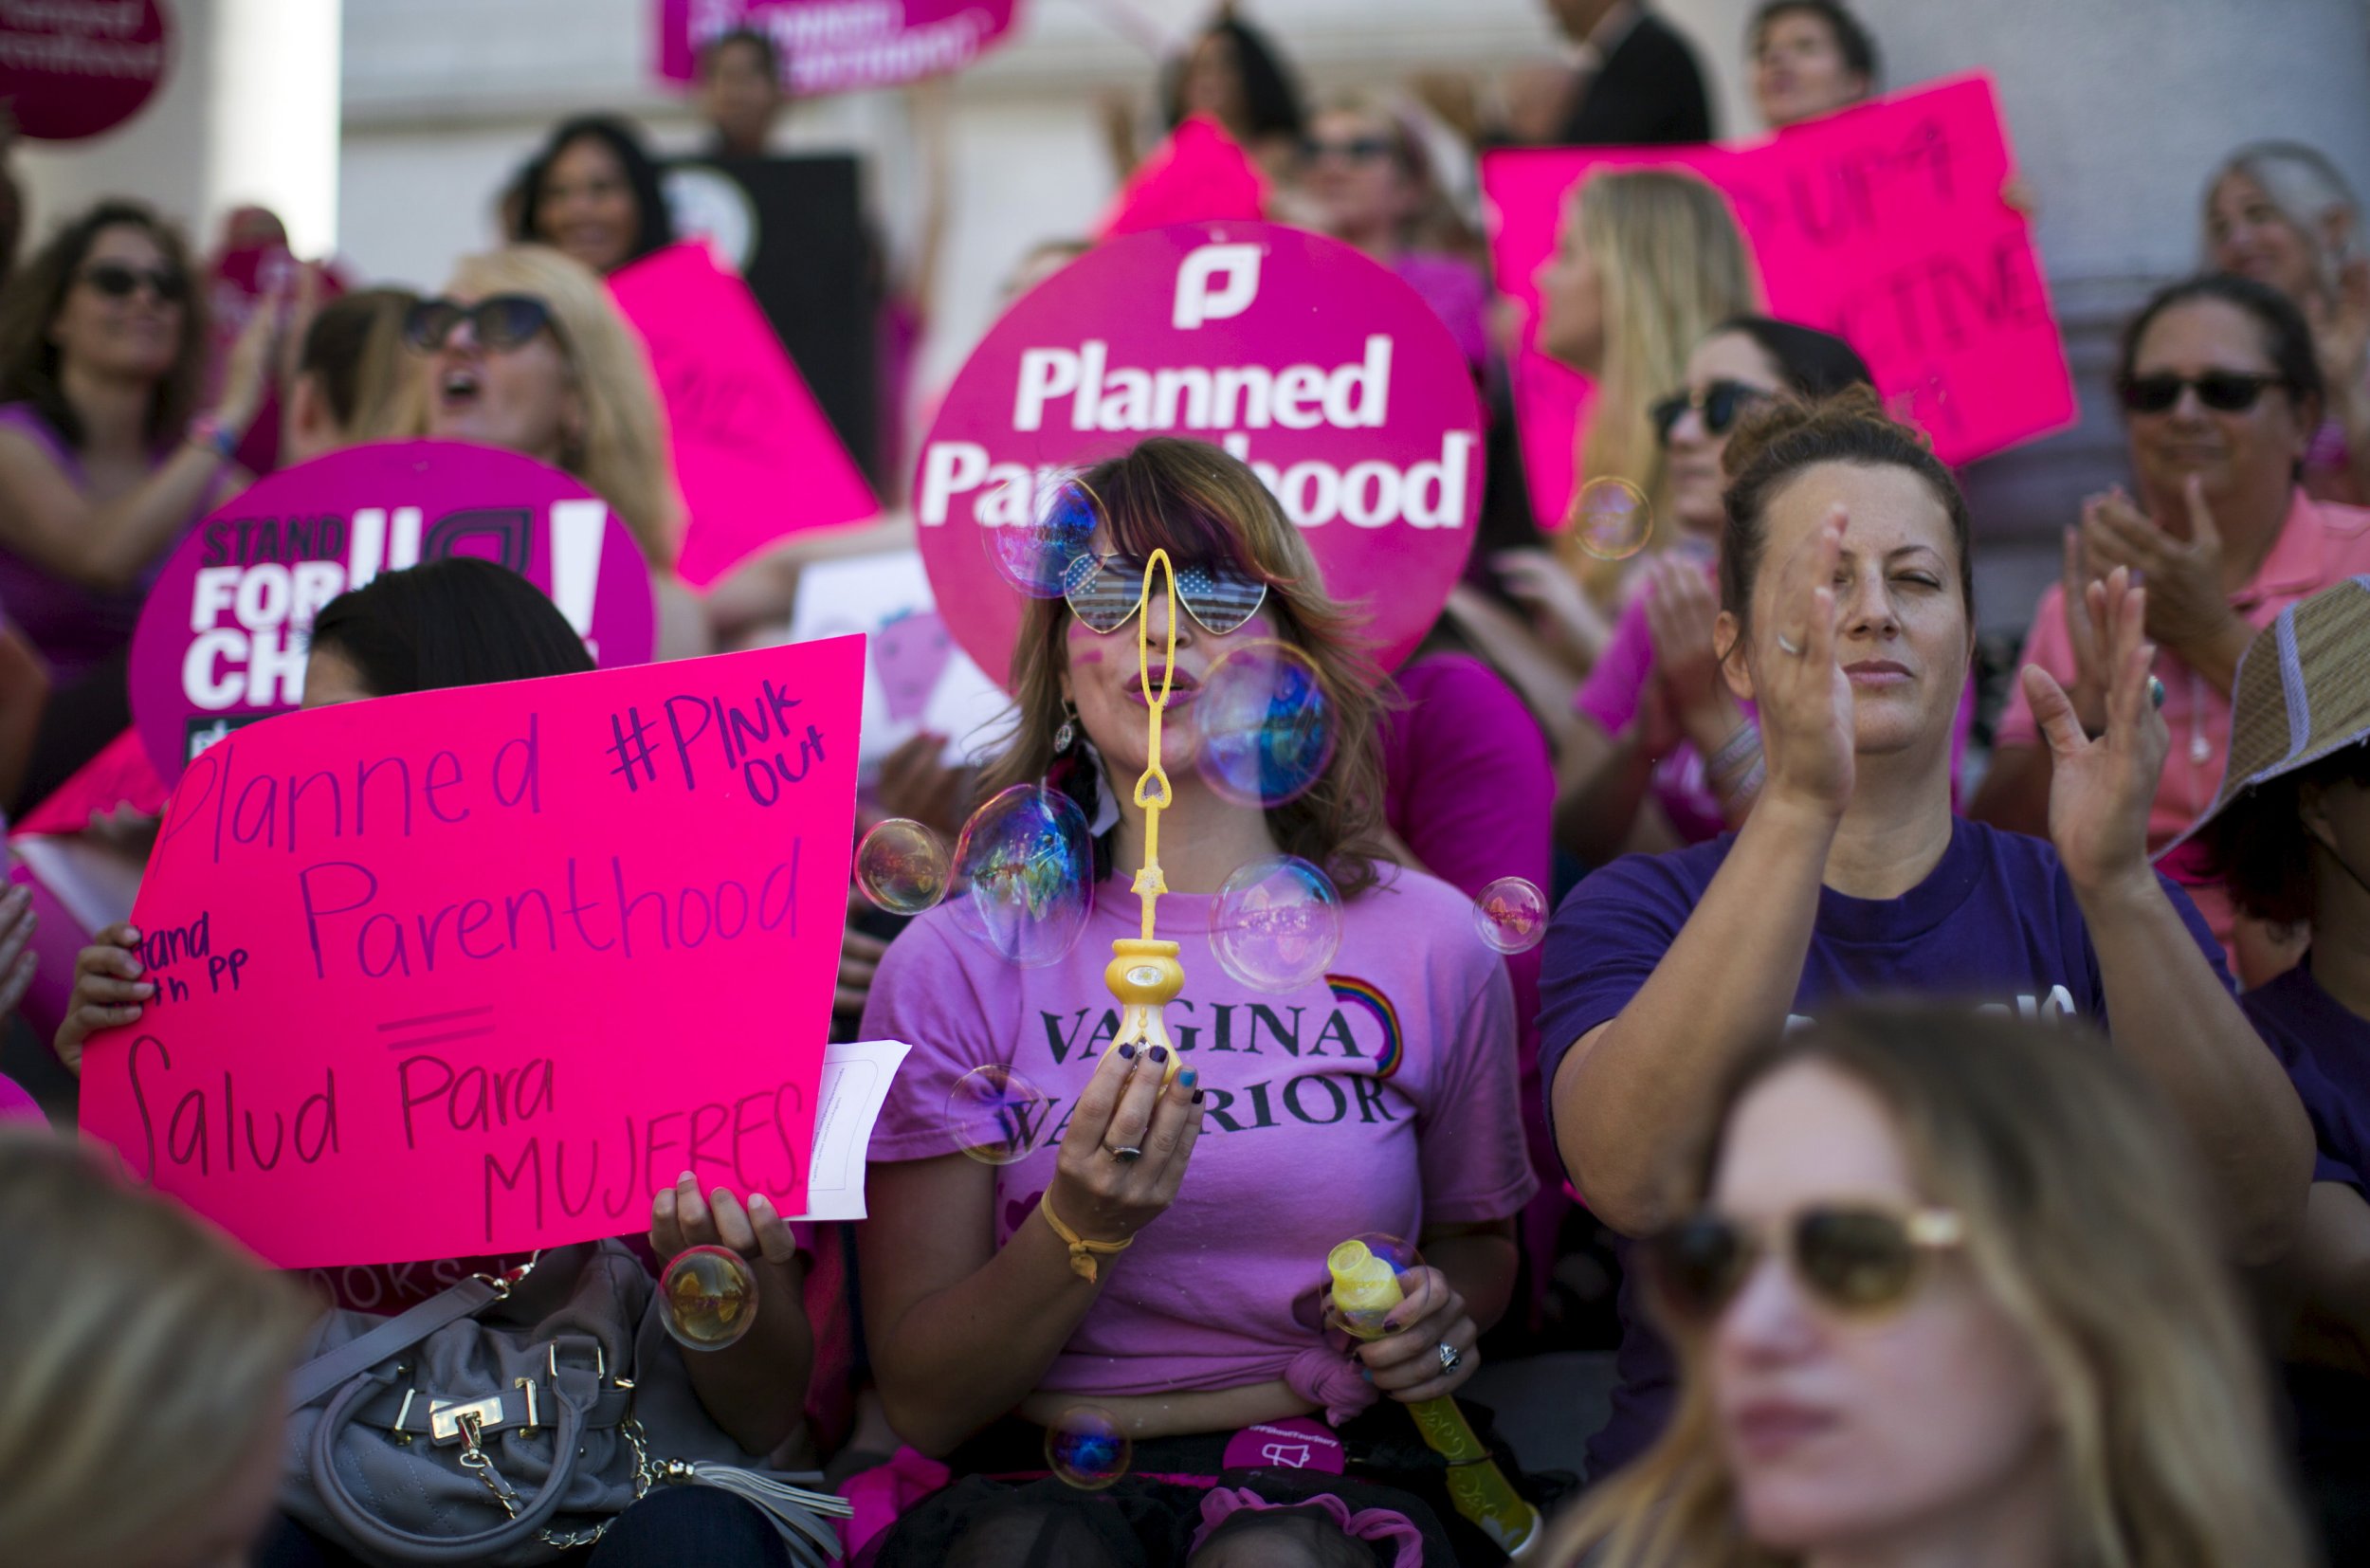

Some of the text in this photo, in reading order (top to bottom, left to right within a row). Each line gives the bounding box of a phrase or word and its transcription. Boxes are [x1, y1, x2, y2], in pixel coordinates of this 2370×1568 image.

[1012, 334, 1394, 432] Planned
[202, 515, 346, 567] STAND
[191, 559, 346, 633] FOR
[154, 712, 541, 879] Planned
[132, 911, 210, 971] tand
[299, 836, 802, 979] Parenthood
[1040, 998, 1373, 1066] VAGINA
[116, 1035, 555, 1187] Salud Para
